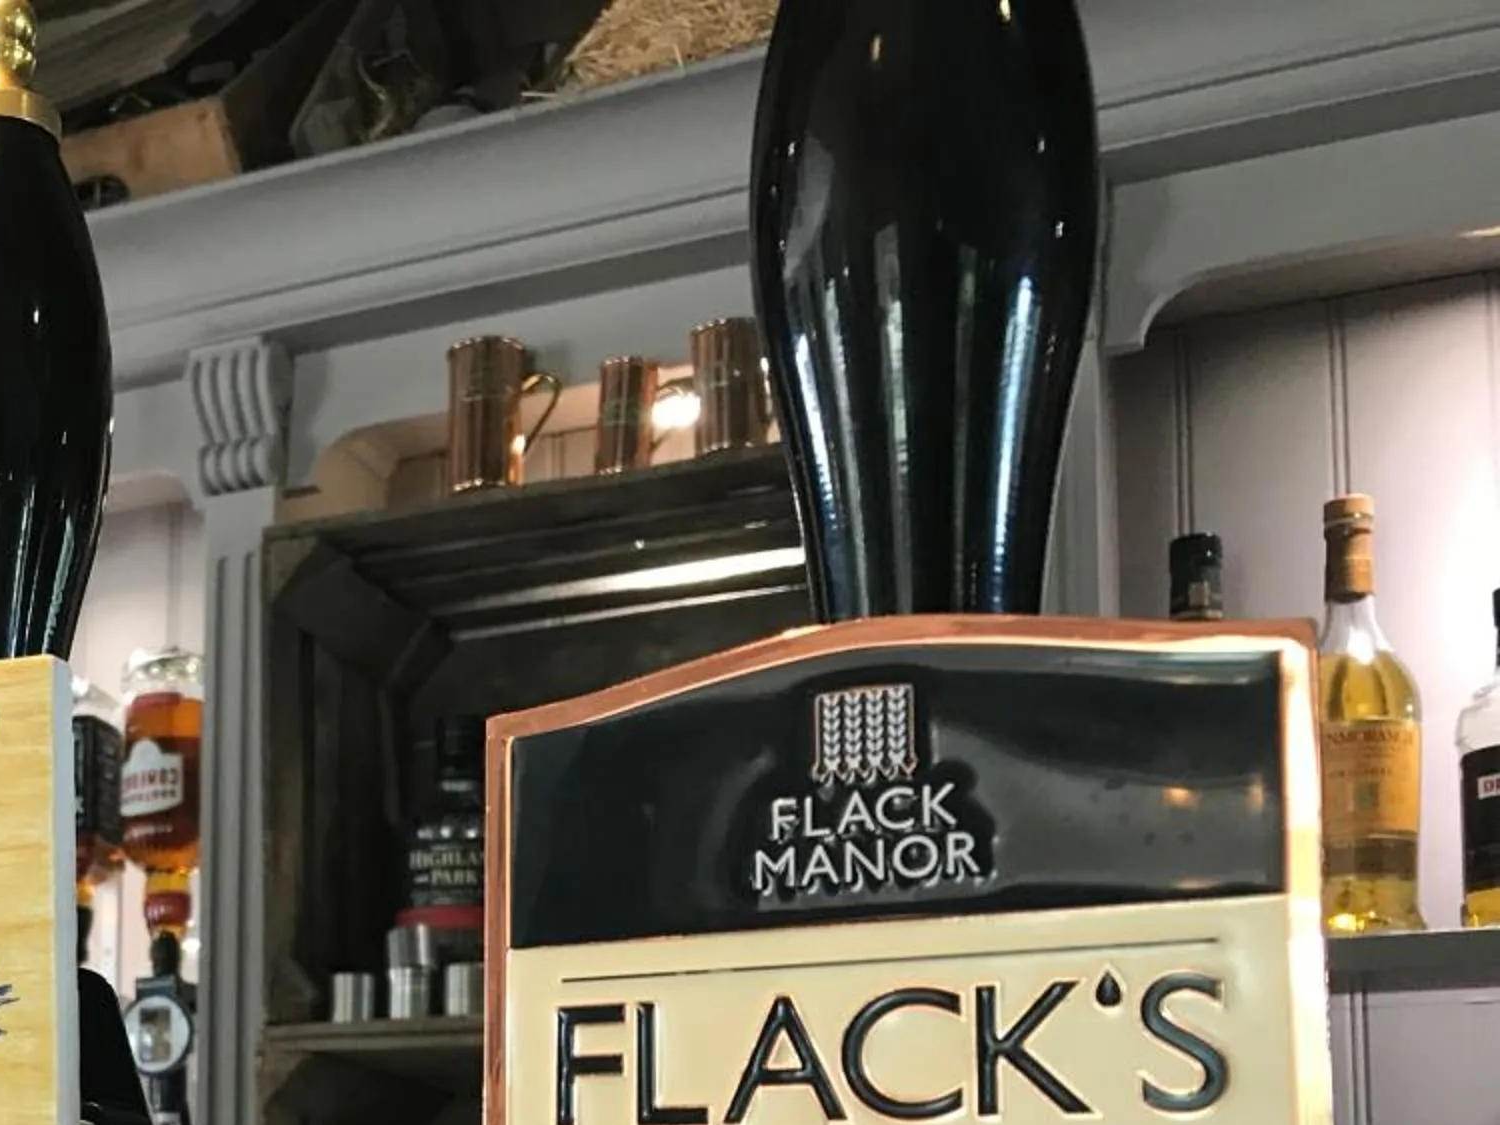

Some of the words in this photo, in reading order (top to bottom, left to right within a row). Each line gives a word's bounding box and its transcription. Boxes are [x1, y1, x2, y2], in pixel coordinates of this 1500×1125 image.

[771, 783, 956, 840] FLACK
[409, 850, 484, 870] HIGHLA
[430, 868, 478, 886] PARK
[755, 832, 980, 890] MANOR
